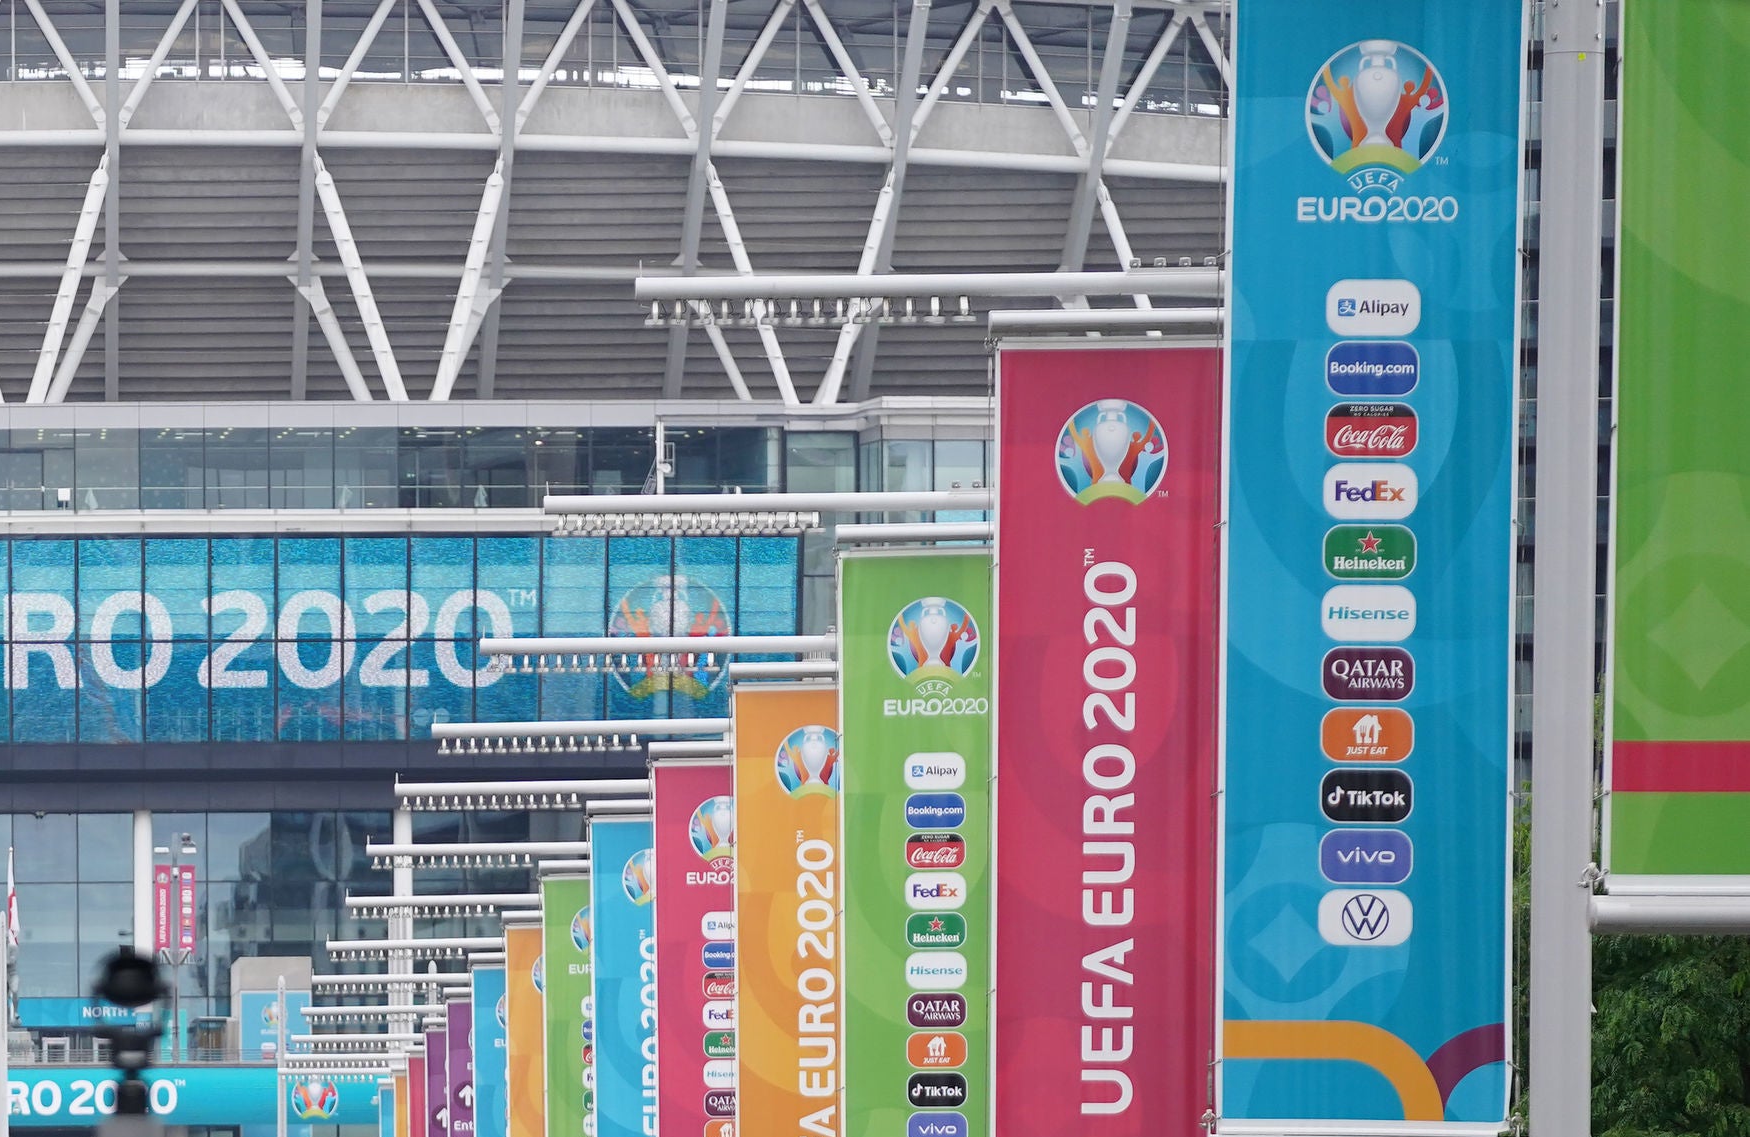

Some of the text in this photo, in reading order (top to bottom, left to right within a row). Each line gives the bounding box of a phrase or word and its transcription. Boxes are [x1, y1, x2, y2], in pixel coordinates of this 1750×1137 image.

[1350, 170, 1400, 193] UEFA
[1297, 196, 1459, 222] EURO2020
[1359, 299, 1410, 317] Alipay
[1329, 361, 1415, 378] Booking.com
[1349, 404, 1395, 412] ZERO SUGAR
[1334, 480, 1405, 501] FedEx
[1333, 556, 1406, 570] Heineken
[1328, 606, 1410, 620] Hisense
[198, 589, 514, 690] 2020
[1331, 659, 1405, 679] QATAR
[918, 682, 950, 696] UEFA
[1348, 678, 1405, 689] AIRWAYS
[884, 698, 989, 716] EURO2020
[1346, 746, 1388, 756] JUST EAT
[925, 766, 958, 777] Alipay
[1347, 790, 1406, 806] TikTok
[907, 805, 963, 817] Booking.com
[1080, 561, 1138, 1115] UEFA EURO 2020
[1337, 847, 1396, 863] vivo
[913, 884, 958, 898] FedEx
[796, 839, 835, 960] 2020
[913, 932, 960, 943] Heineken
[910, 966, 963, 975] Hisense
[913, 1000, 960, 1014] QATAR
[708, 1009, 734, 1020] FedE
[924, 1012, 961, 1020] AIRWAYS
[797, 967, 836, 1097] EURO
[68, 1079, 178, 1116] 200
[924, 1086, 963, 1097] TikTok
[919, 1123, 957, 1134] vivo
